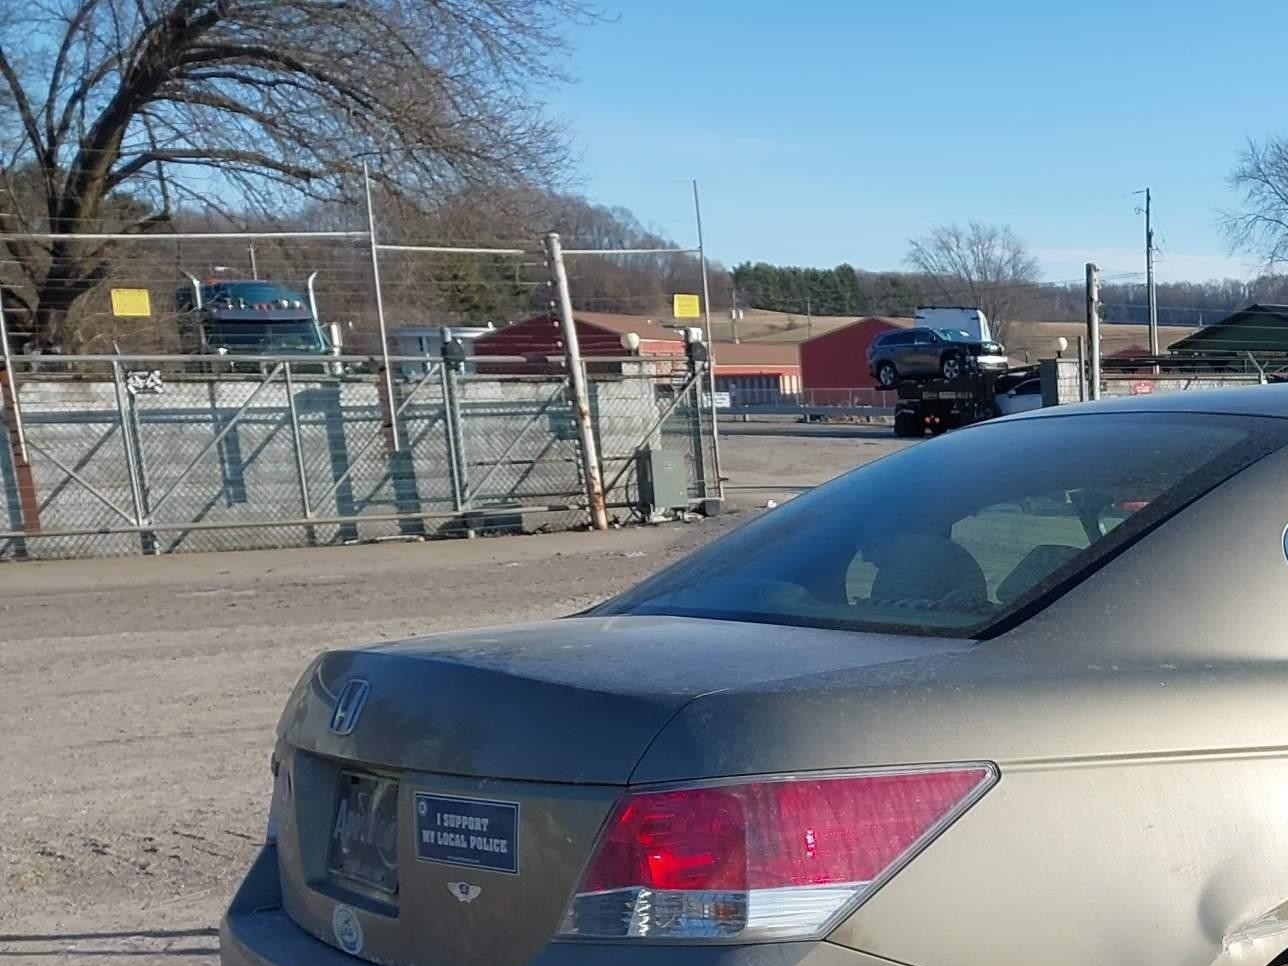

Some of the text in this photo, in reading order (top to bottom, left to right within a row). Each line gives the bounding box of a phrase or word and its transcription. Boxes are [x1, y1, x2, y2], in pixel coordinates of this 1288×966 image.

[436, 812, 489, 832] I SUPPORT
[437, 831, 467, 849] LOCAL
[470, 836, 508, 854] POLICE
